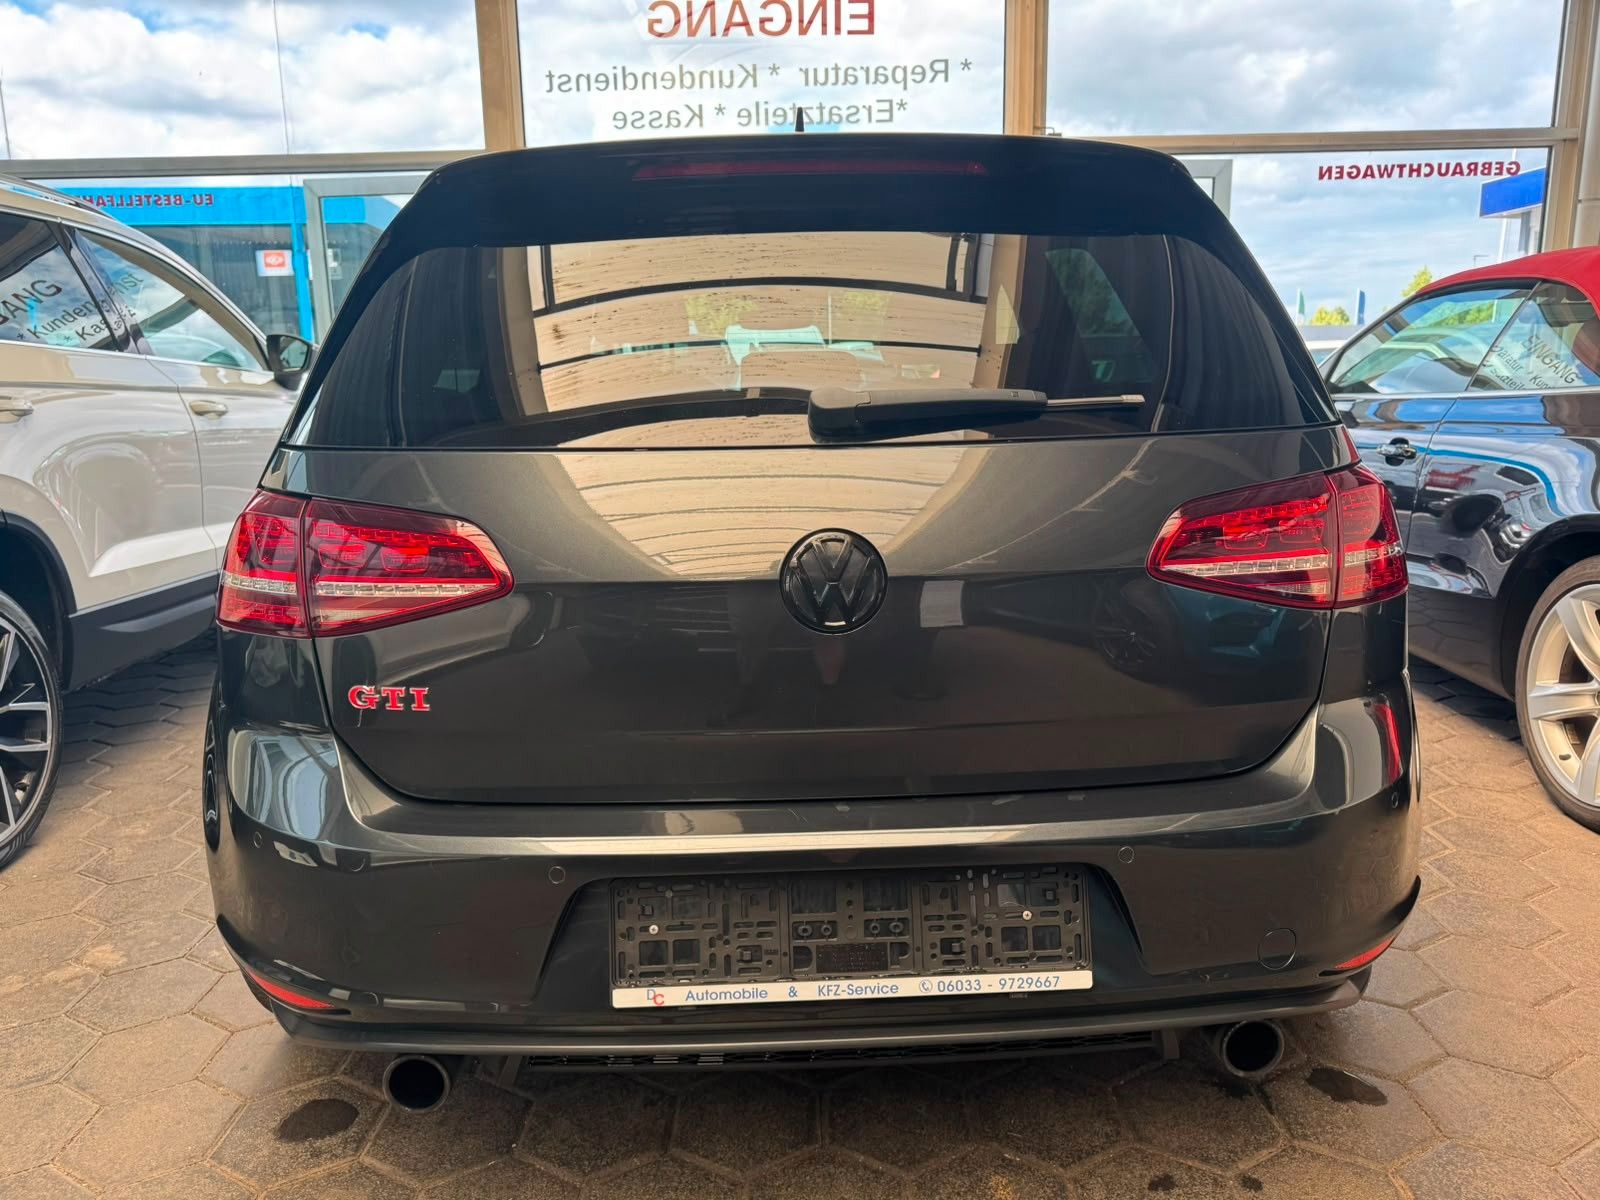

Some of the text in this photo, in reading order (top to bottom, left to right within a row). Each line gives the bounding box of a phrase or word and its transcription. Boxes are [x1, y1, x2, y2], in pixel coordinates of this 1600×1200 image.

[347, 684, 431, 711] GTI
[685, 988, 769, 1002] Automobile
[788, 985, 799, 998] &
[817, 983, 900, 997] KFZ-Service
[937, 979, 982, 993] 06033
[998, 975, 1061, 991] 9729667
